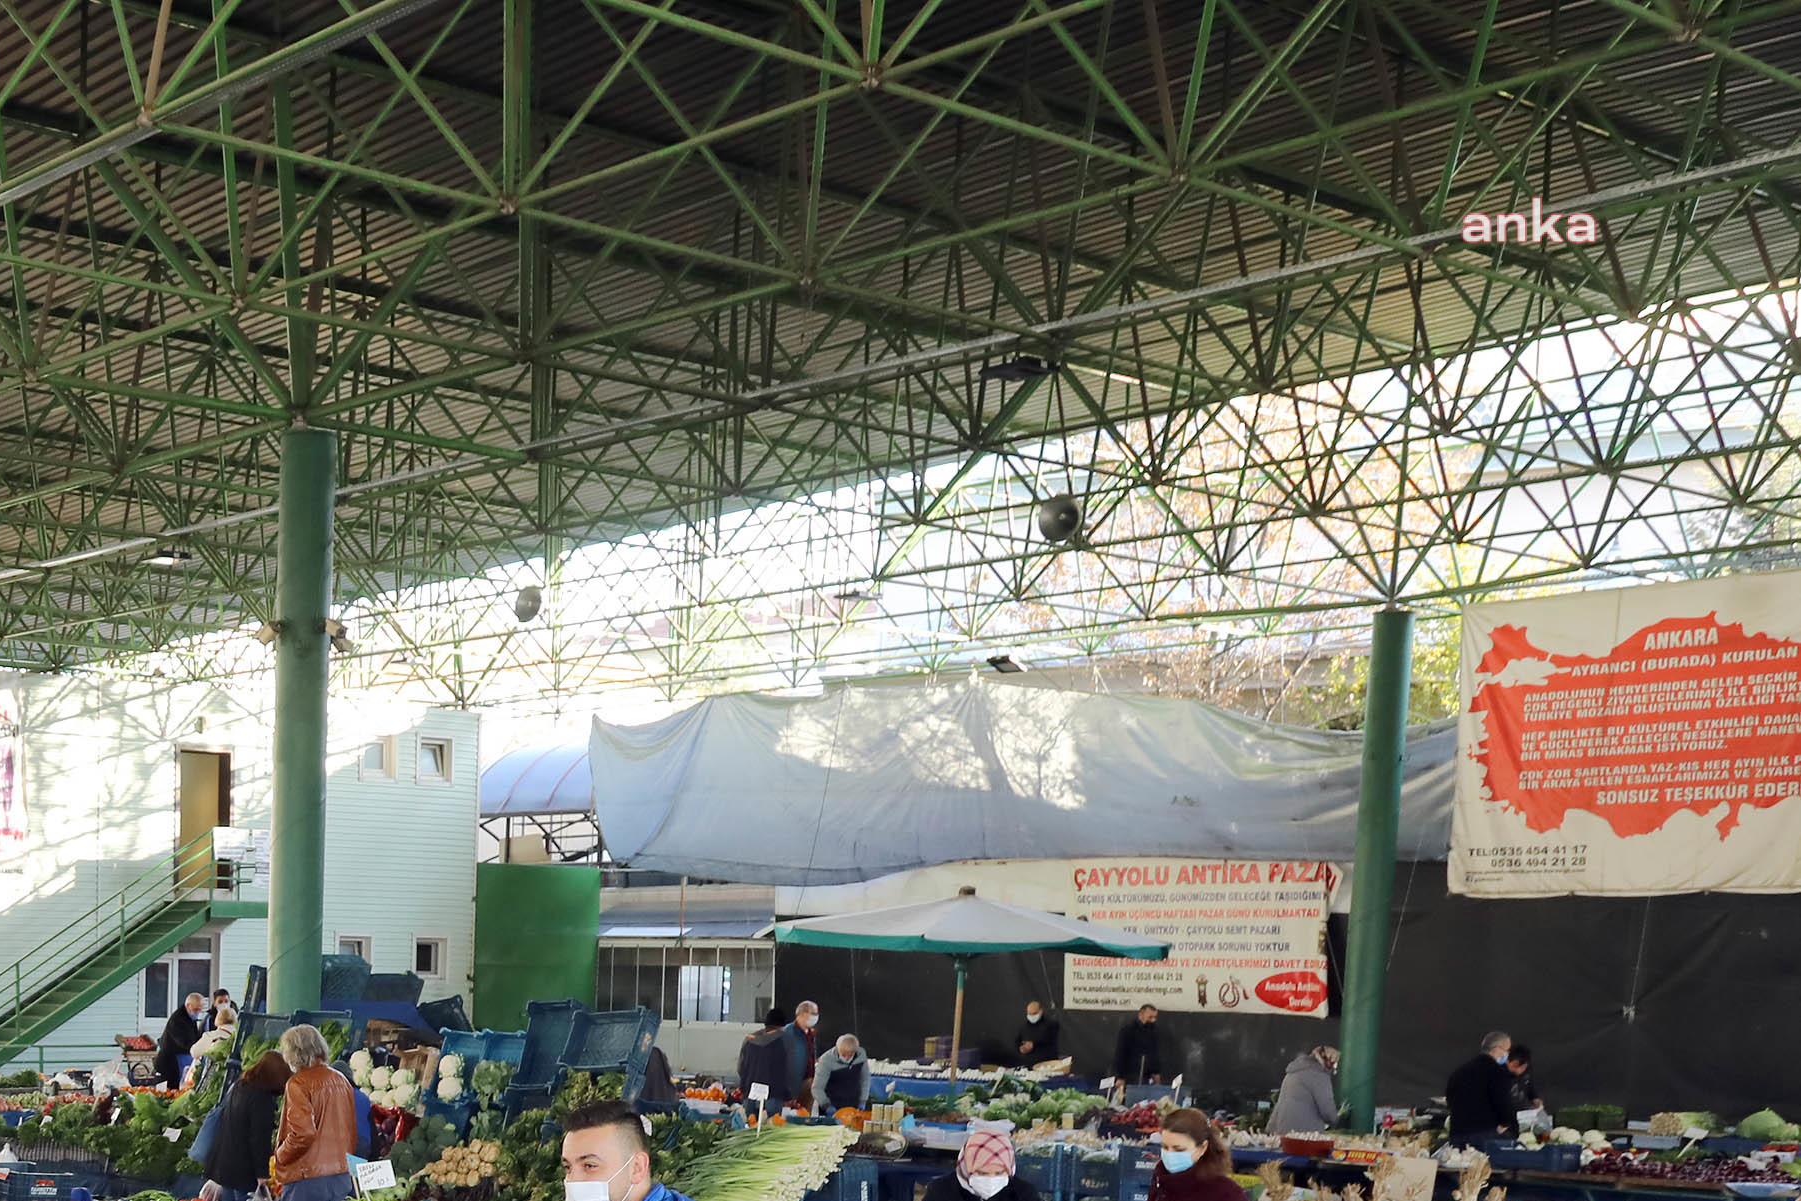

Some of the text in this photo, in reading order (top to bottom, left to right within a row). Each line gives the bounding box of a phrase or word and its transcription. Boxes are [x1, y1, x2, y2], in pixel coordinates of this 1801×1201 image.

[1643, 627, 1719, 650] ANKARA
[1571, 646, 1799, 677] AYRANCI (BURADA) KURULAN
[1702, 676, 1744, 689] GELEN
[1596, 788, 1660, 806] SONSUZ
[1664, 781, 1750, 804] TEŞEKKÜR
[1074, 866, 1170, 892] ÇAYYOLU
[1176, 860, 1261, 884] ANTİKA
